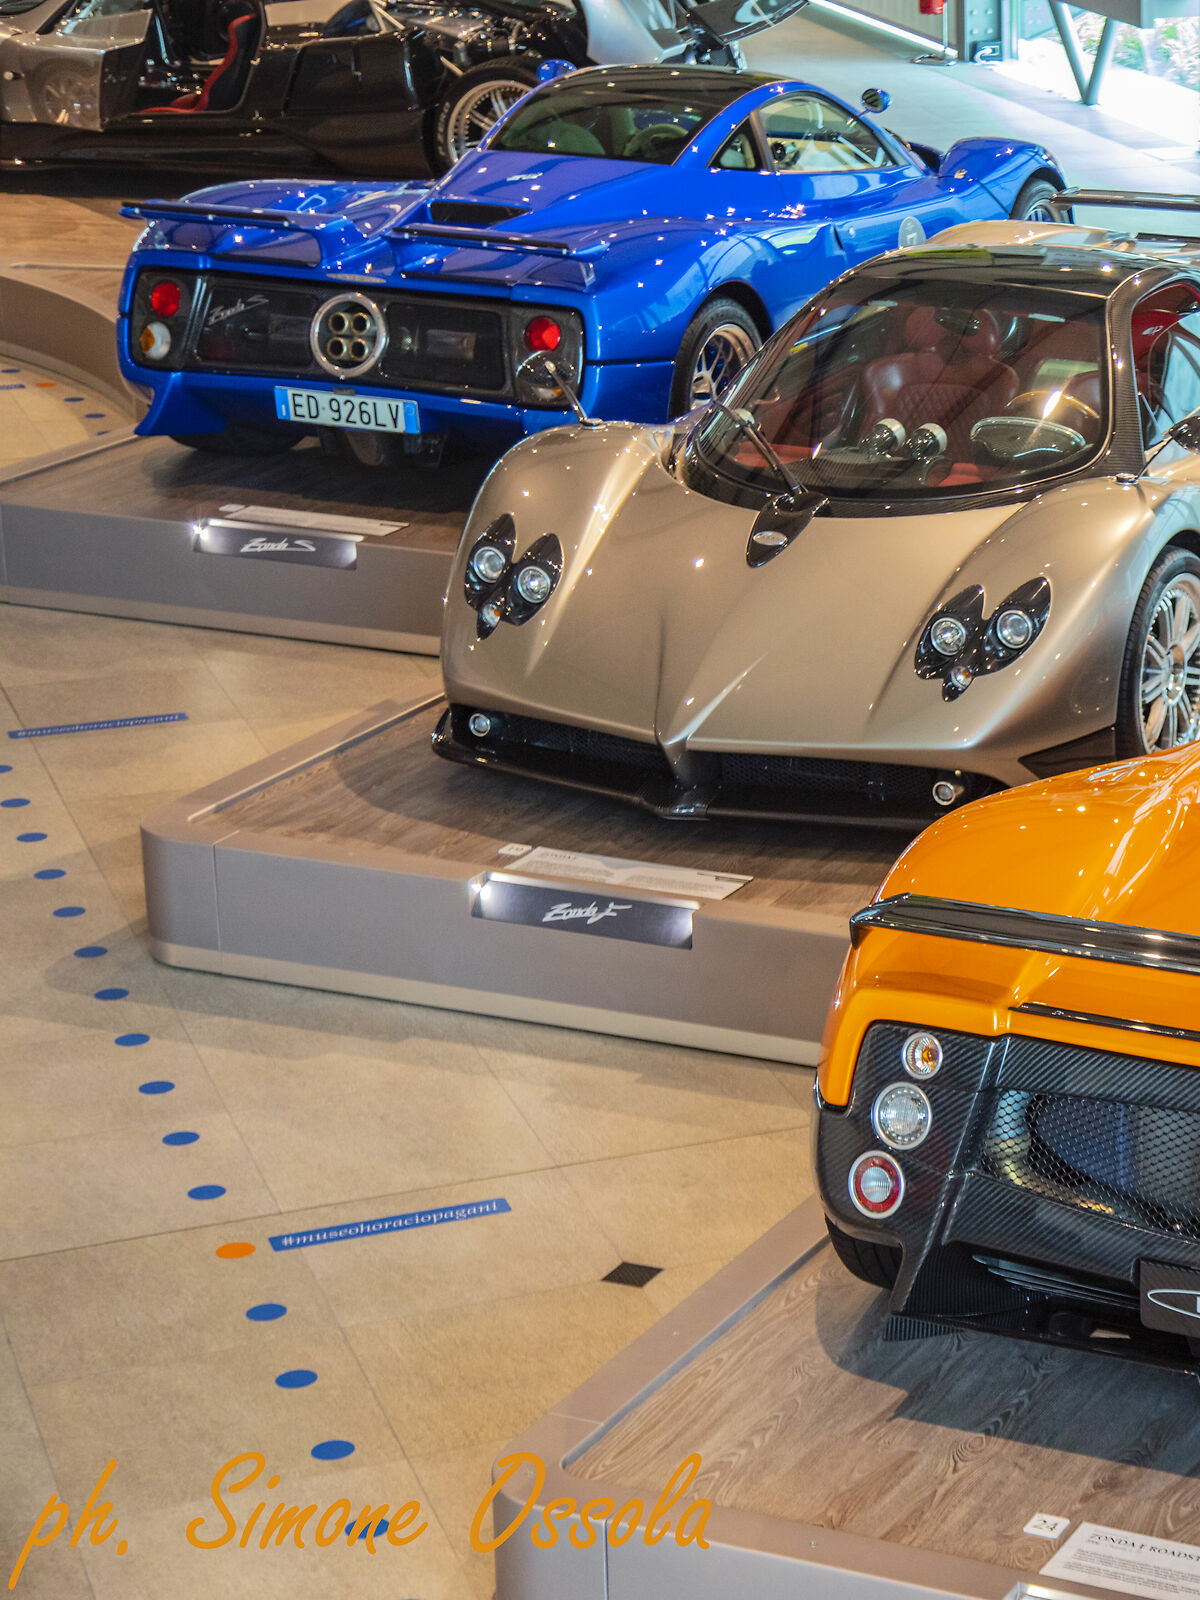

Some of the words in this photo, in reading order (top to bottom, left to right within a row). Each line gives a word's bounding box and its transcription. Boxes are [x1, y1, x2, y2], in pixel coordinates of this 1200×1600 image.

[292, 392, 320, 420] ED
[328, 398, 400, 429] 926LV
[240, 537, 291, 553] Zonda
[542, 901, 598, 923] Zonda
[281, 1200, 499, 1247] #museohoraciopagani
[1032, 1519, 1059, 1532] 24
